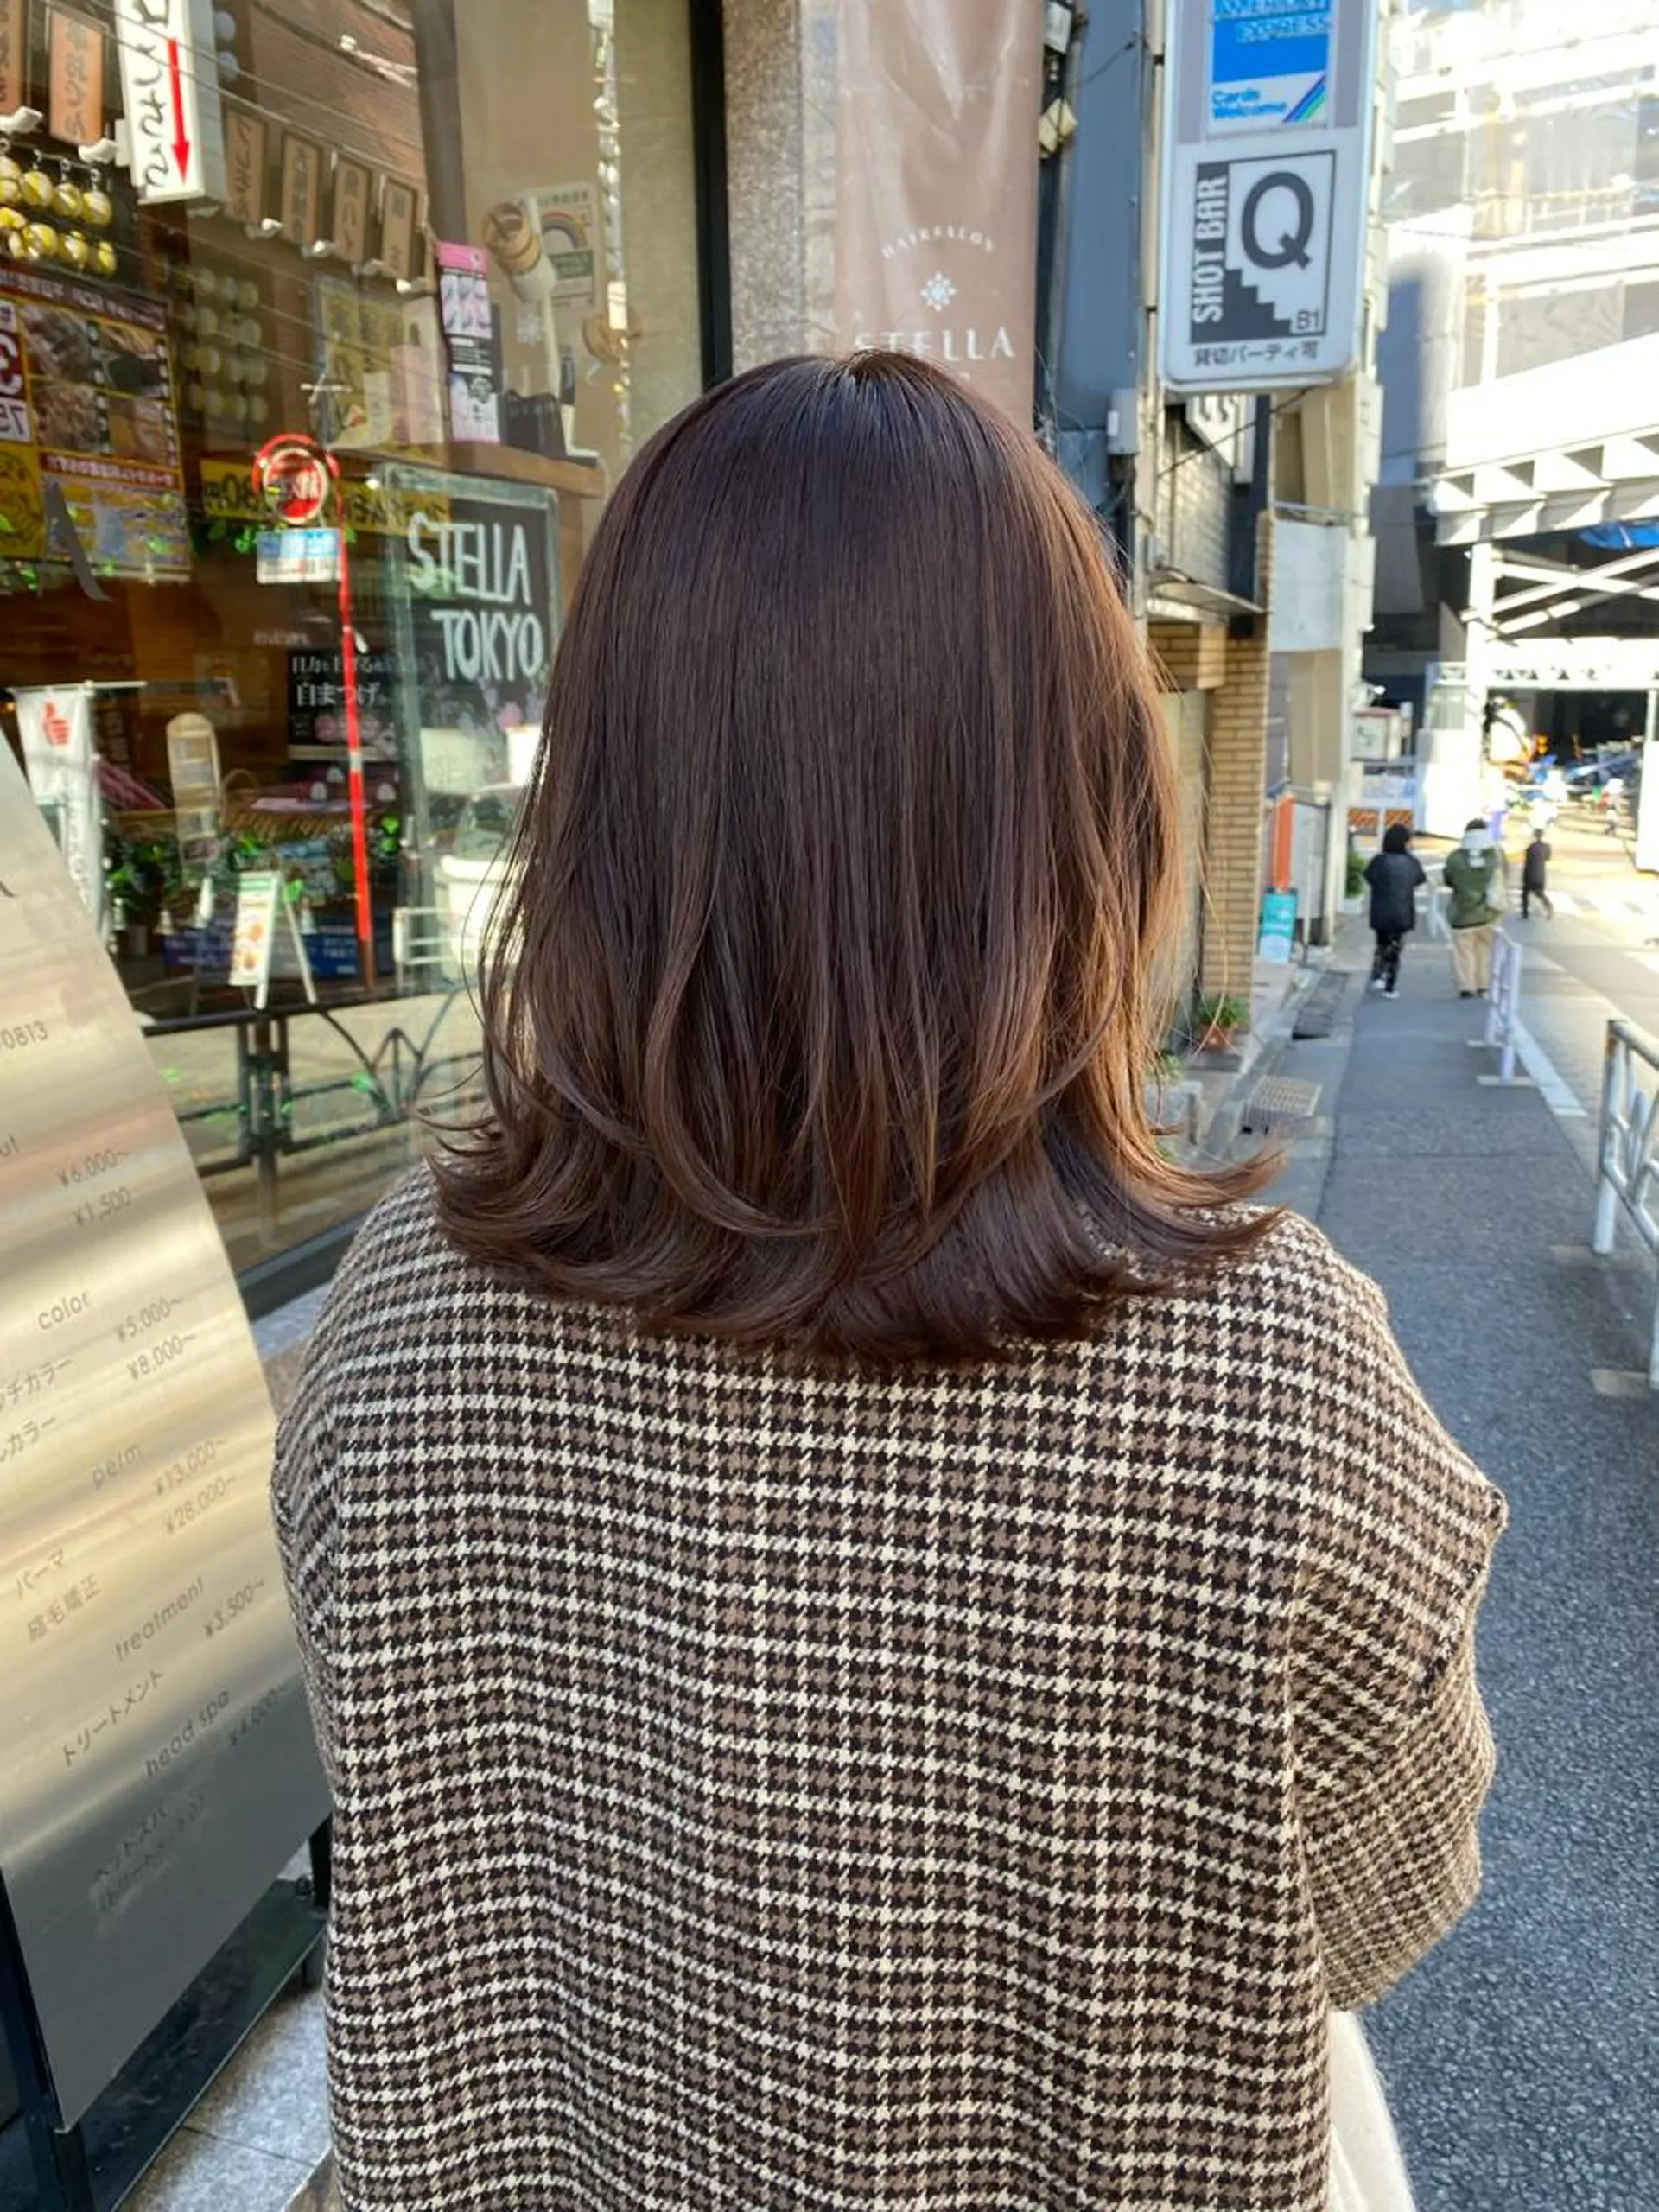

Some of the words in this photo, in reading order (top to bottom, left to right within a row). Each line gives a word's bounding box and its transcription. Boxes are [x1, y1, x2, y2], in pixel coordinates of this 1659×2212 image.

[1196, 176, 1227, 240] BAR
[1242, 171, 1313, 270] Q
[1192, 248, 1224, 323] SHOT
[1297, 309, 1319, 330] B1
[407, 512, 531, 606] STELLA
[430, 608, 545, 683] TOKYO
[38, 1292, 89, 1329] color
[92, 1443, 142, 1491] perm
[114, 1575, 205, 1662] treatment
[62, 1669, 164, 1768] トリートメント
[143, 1719, 196, 1777] head
[197, 1690, 231, 1731] spa
